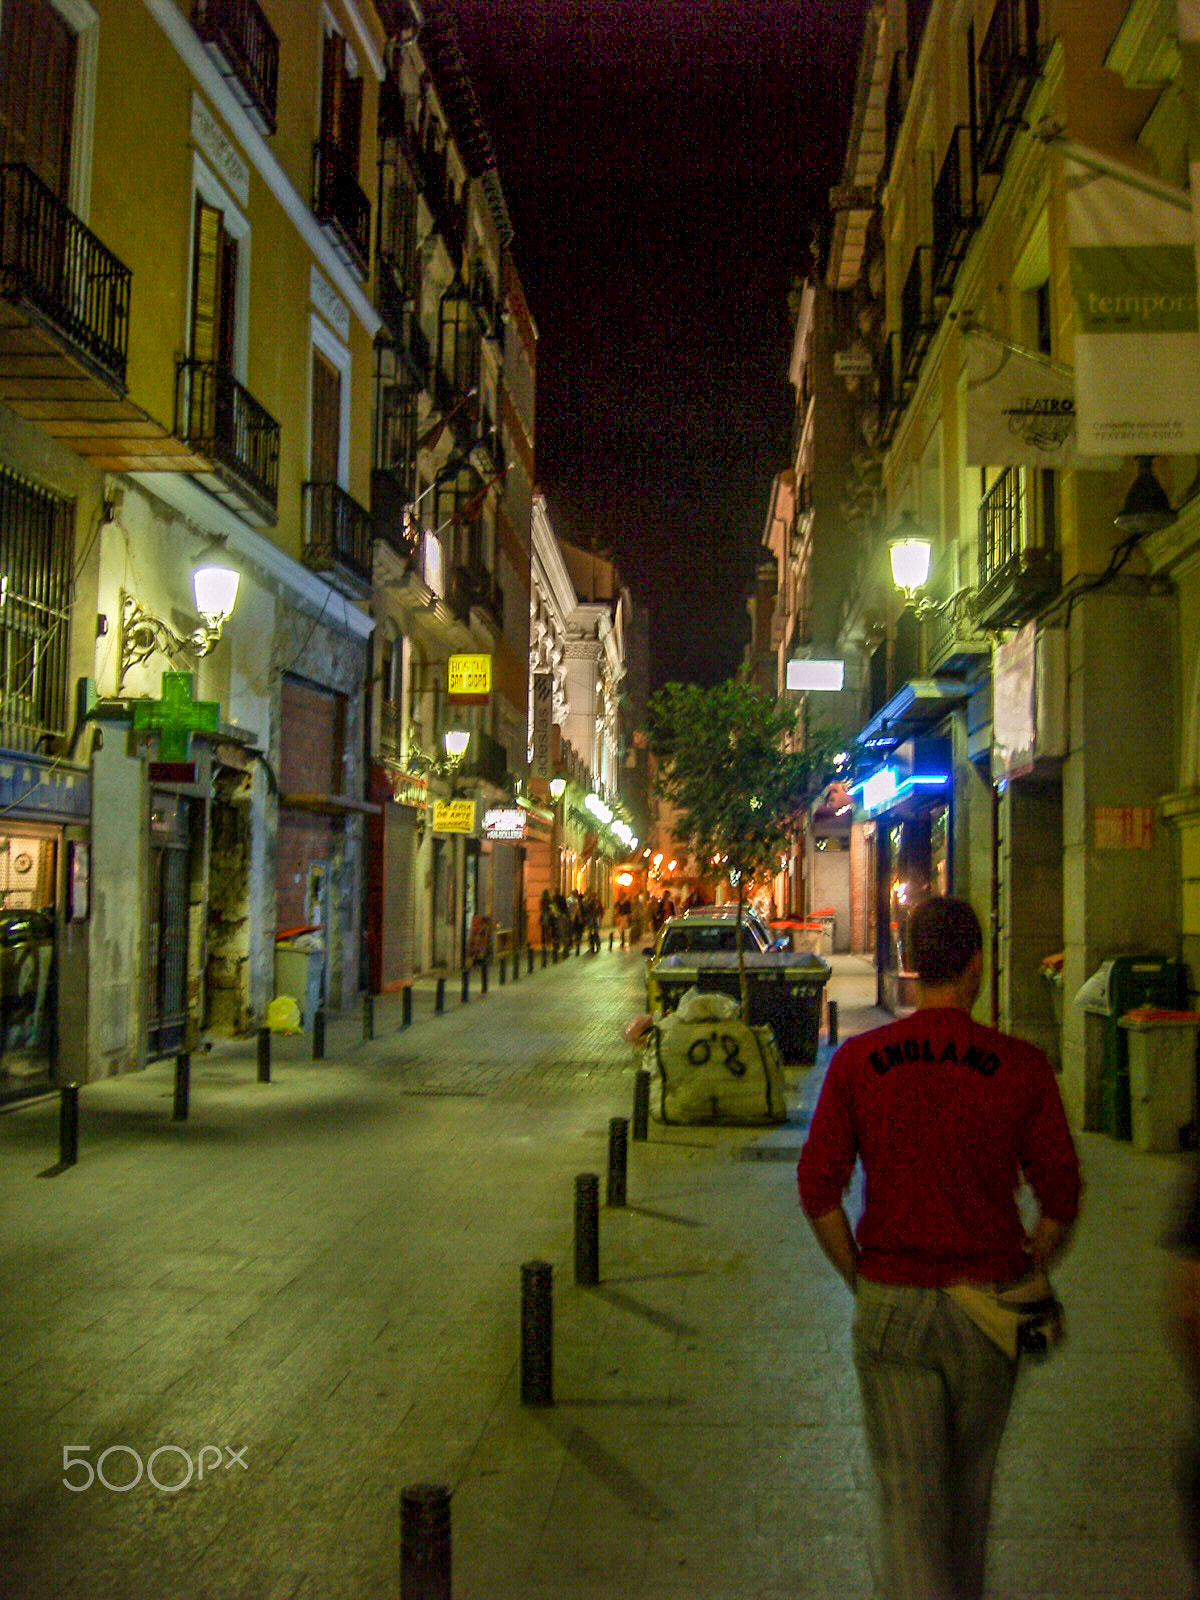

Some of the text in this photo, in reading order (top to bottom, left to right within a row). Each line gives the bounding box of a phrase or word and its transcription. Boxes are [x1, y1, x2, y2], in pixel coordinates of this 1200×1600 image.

[1019, 398, 1074, 411] TEATRO
[451, 659, 488, 672] HOSTAL
[537, 707, 549, 777] adeslas
[869, 1037, 1001, 1076] ENGLAND
